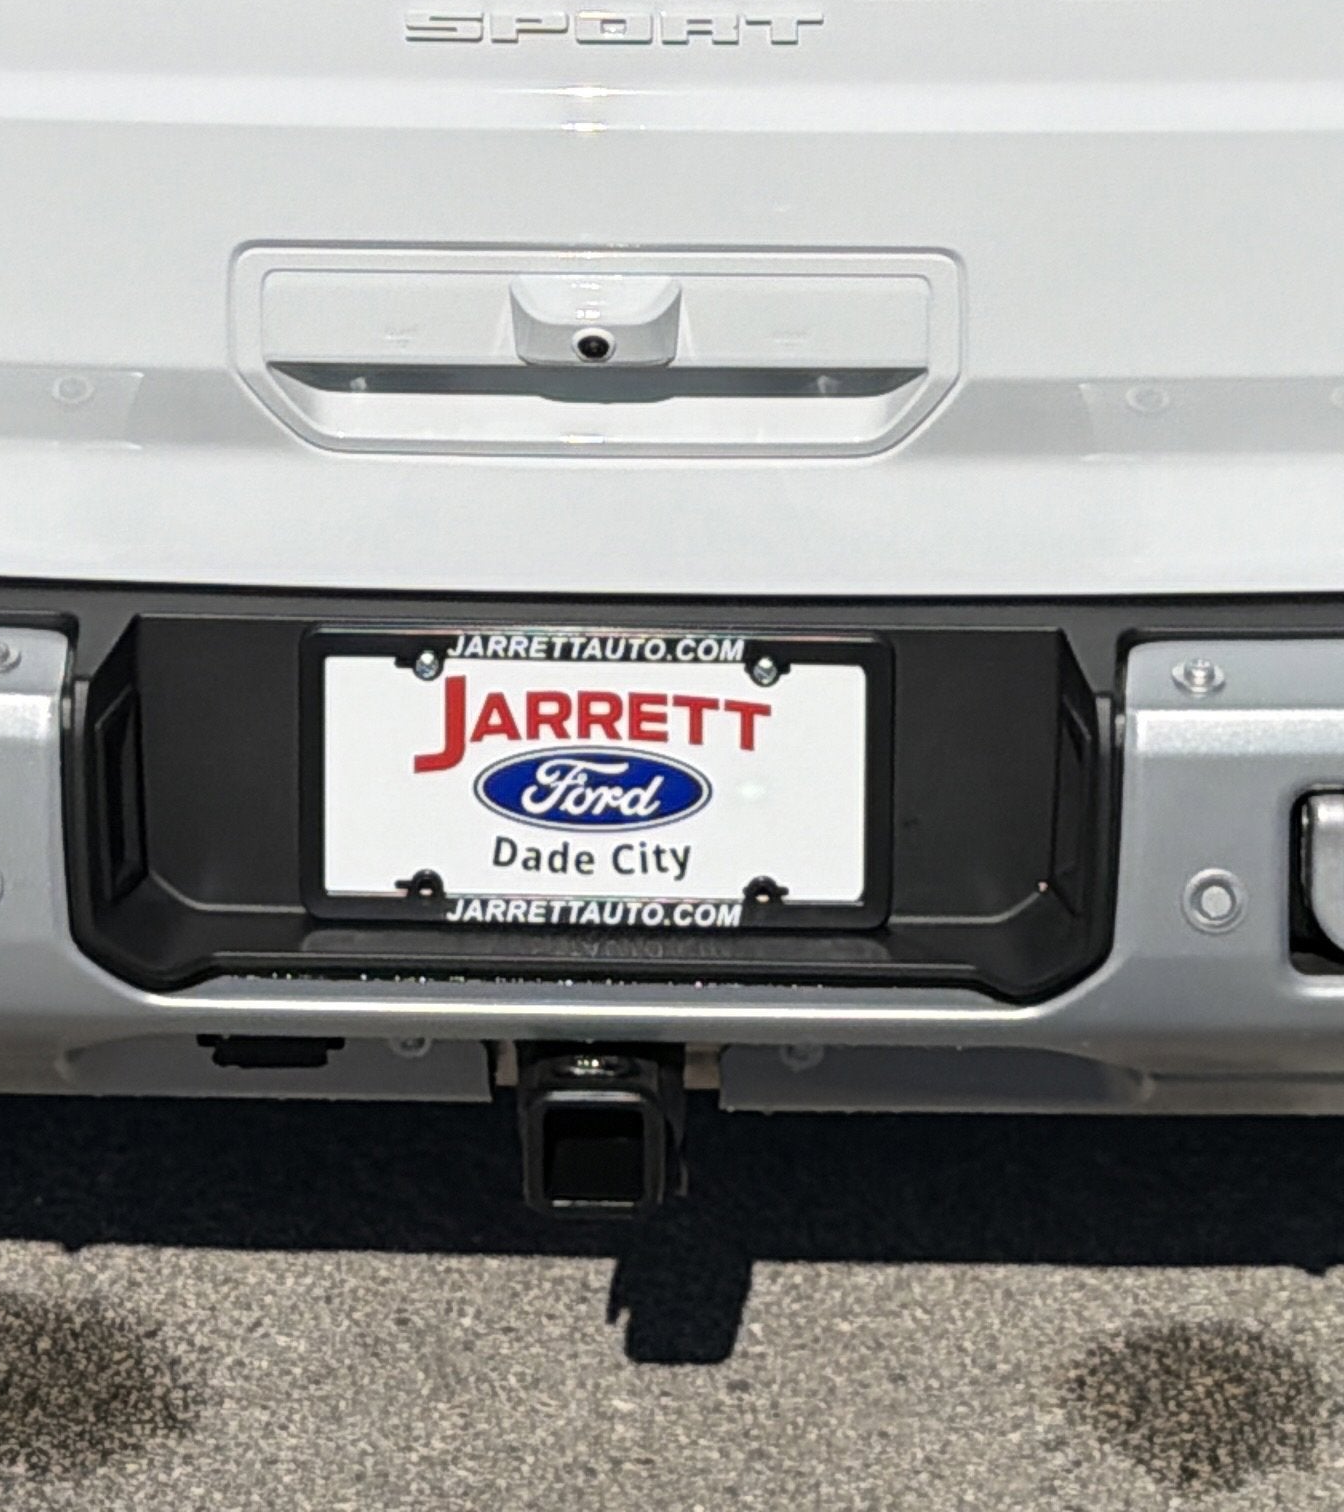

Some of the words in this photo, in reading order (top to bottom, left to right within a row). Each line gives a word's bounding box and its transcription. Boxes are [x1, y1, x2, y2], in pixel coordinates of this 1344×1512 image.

[405, 9, 824, 44] SPORT
[447, 635, 746, 662] JARRETTAUTO.COM
[414, 675, 772, 774] JARRETT
[521, 759, 665, 817] Ford
[492, 836, 595, 875] Dade
[612, 841, 691, 881] City
[446, 899, 742, 928] JARRETTAUTO.COM
